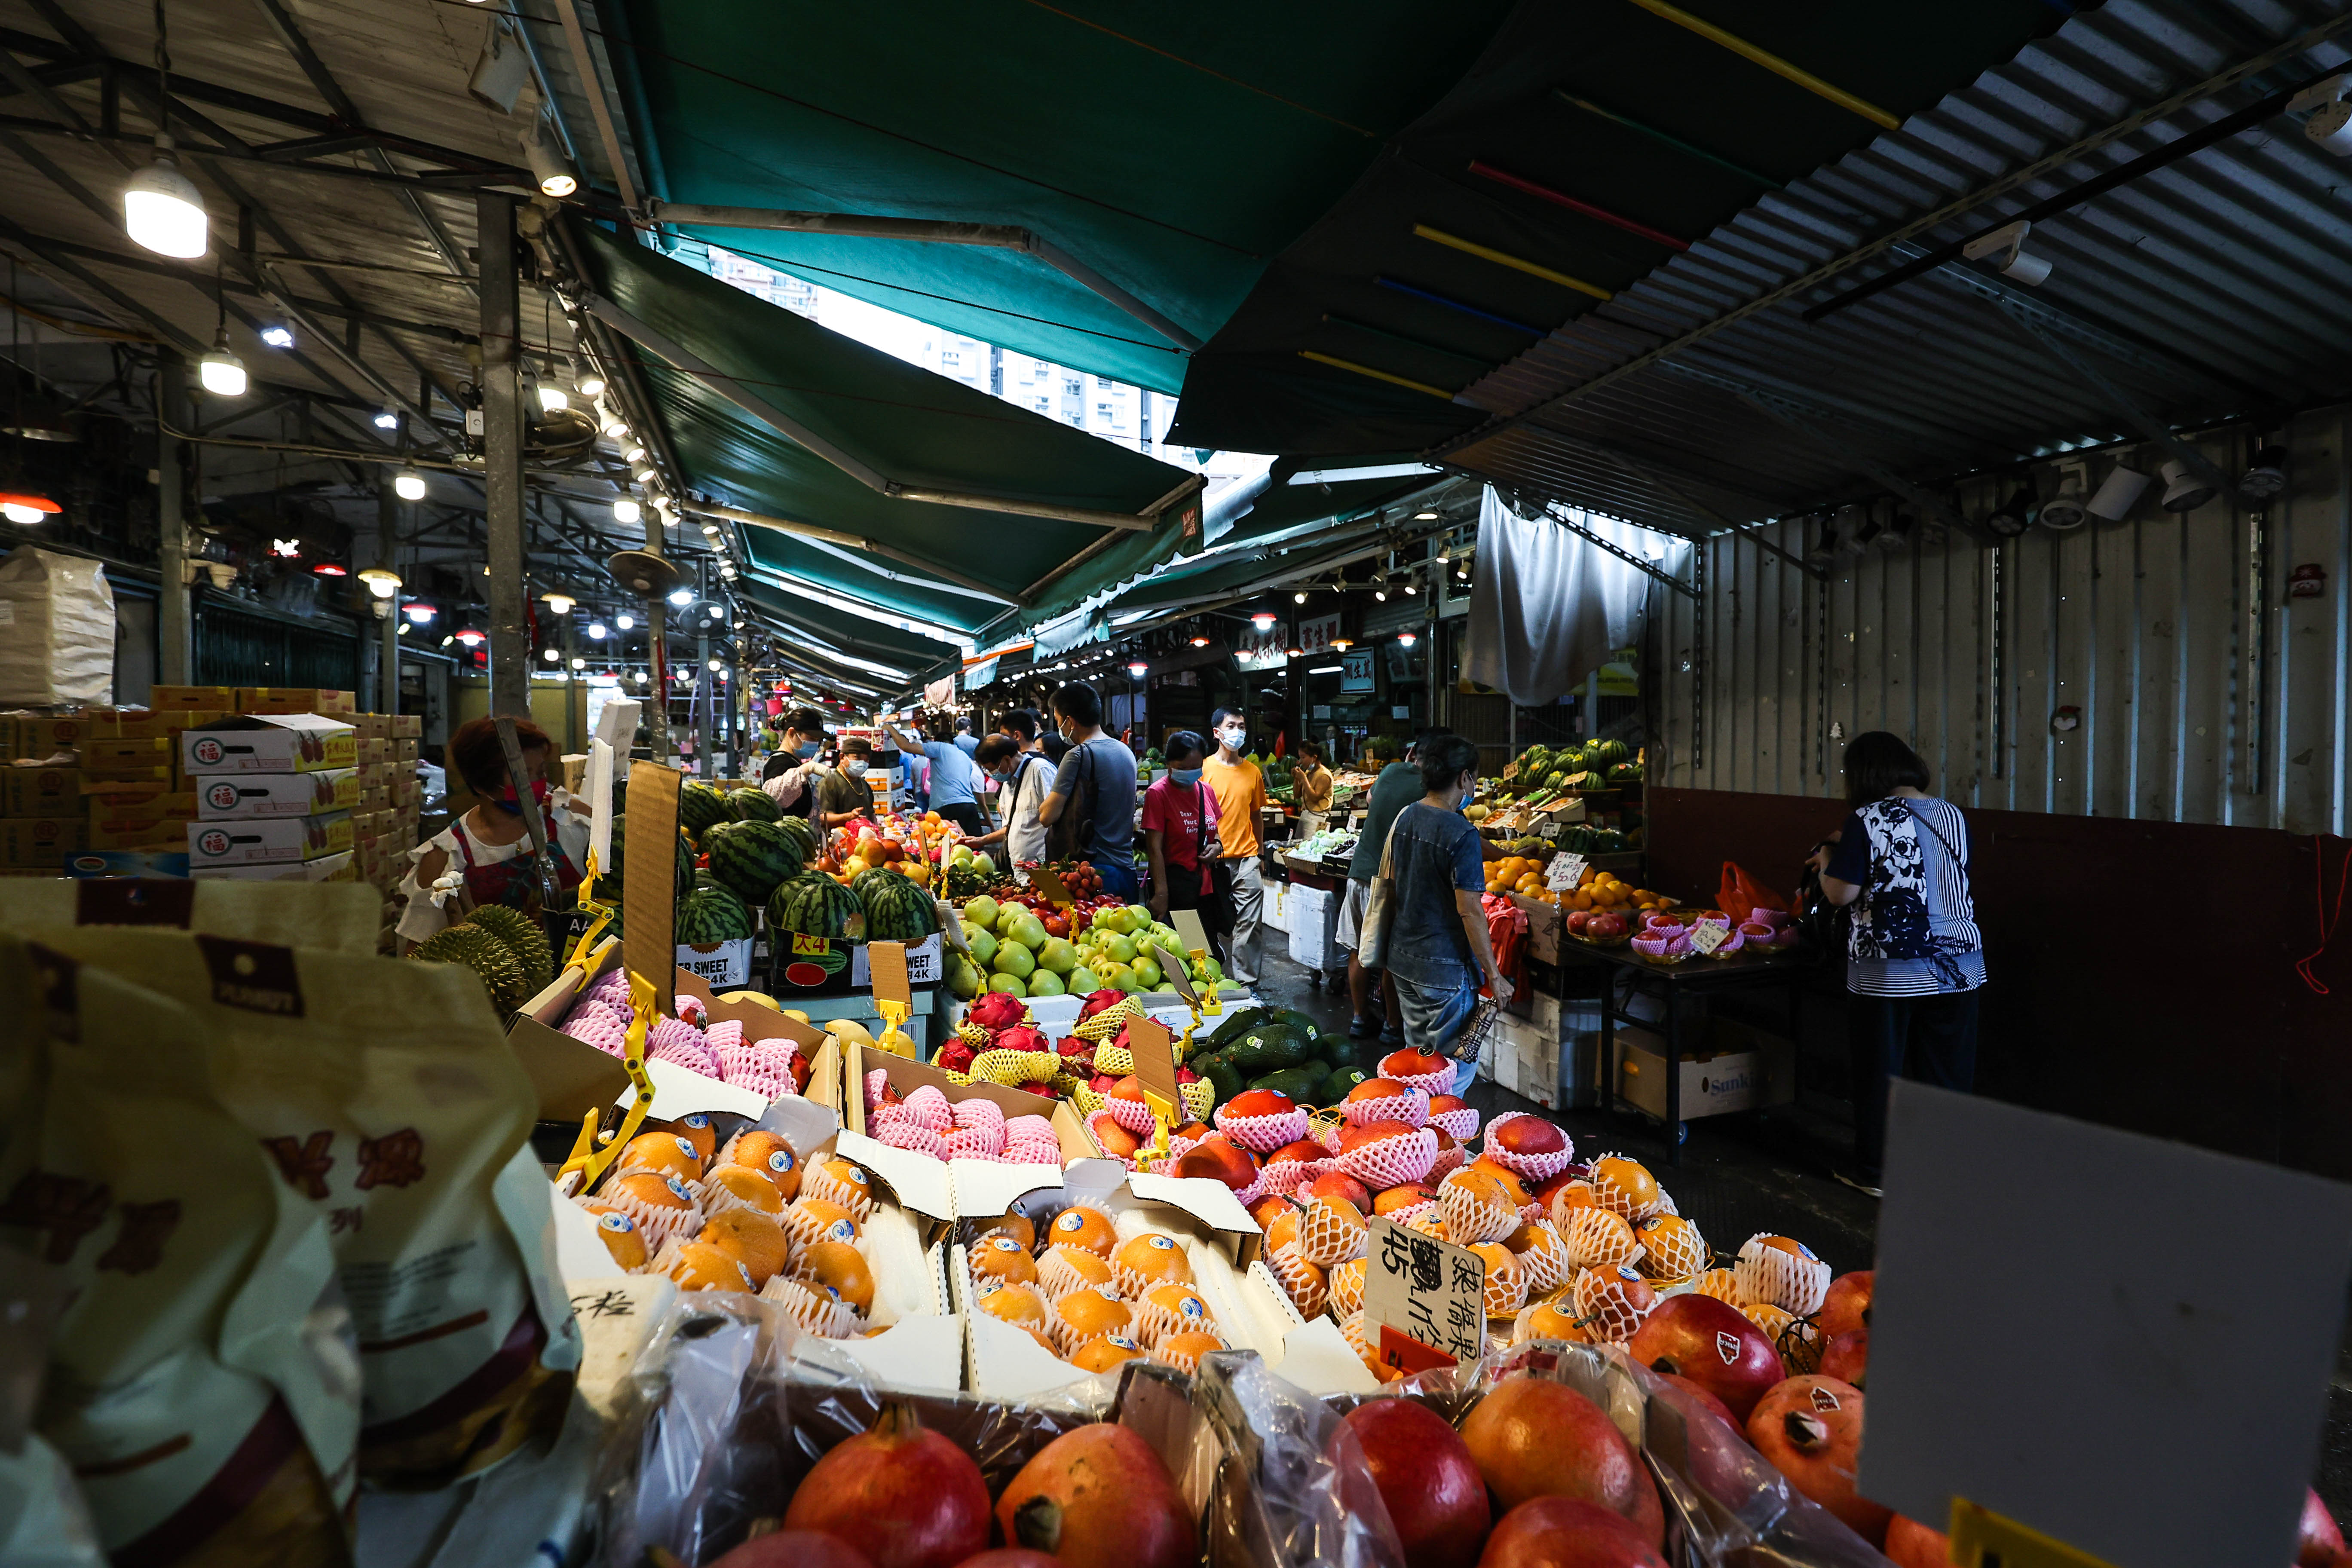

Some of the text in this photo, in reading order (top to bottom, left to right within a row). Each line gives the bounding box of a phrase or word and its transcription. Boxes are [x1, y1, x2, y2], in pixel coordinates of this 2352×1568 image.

[200, 743, 219, 760] 福
[214, 788, 233, 805] 福
[206, 834, 225, 851] 福
[694, 958, 728, 974] SWEET
[906, 955, 930, 968] WEET
[1382, 1225, 1409, 1280] 45
